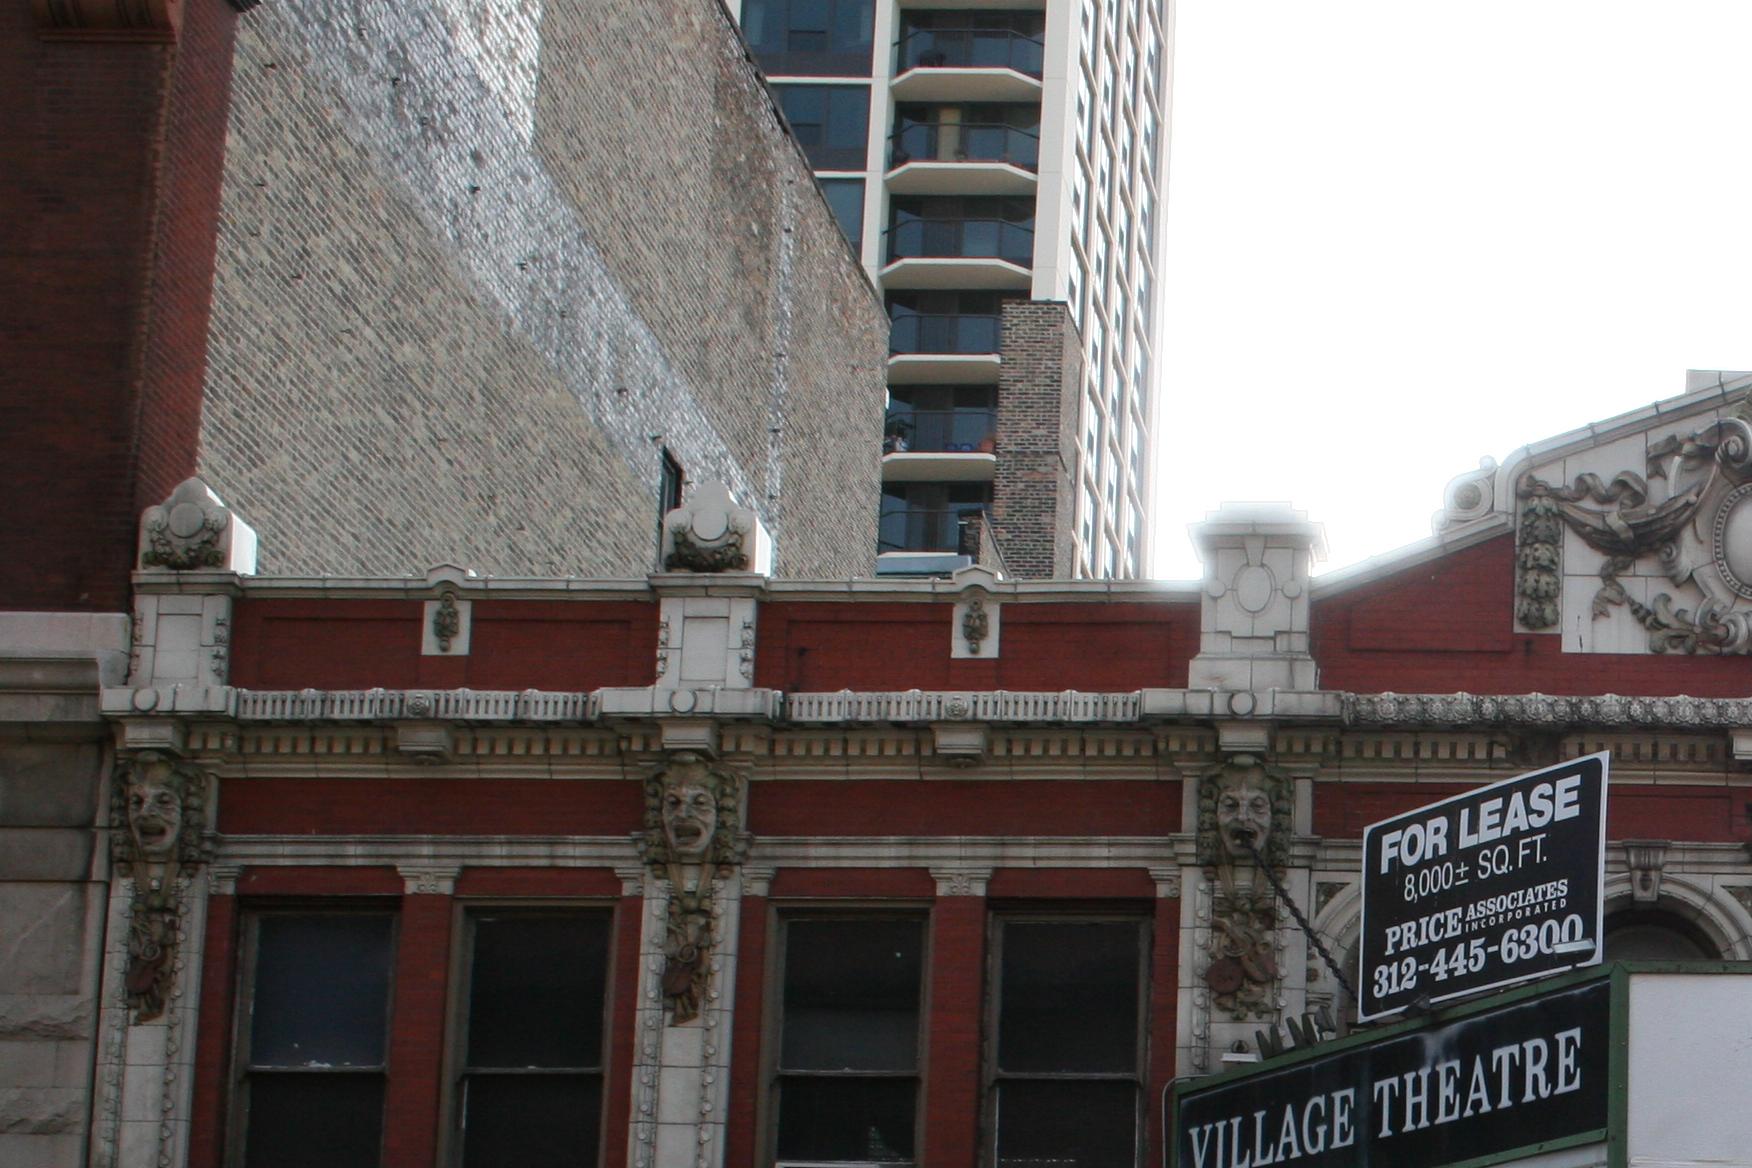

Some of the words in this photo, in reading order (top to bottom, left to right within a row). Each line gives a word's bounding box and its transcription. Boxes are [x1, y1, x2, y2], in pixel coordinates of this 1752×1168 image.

[1380, 815, 1448, 875] FOR
[1458, 774, 1581, 848] LEASE
[1385, 905, 1462, 956] PRICE
[1465, 879, 1569, 921] ASSOCIATES
[1465, 899, 1568, 932] INCORPORATED
[1373, 913, 1584, 999] 312-445-6300
[1373, 1027, 1582, 1138] THEATRE
